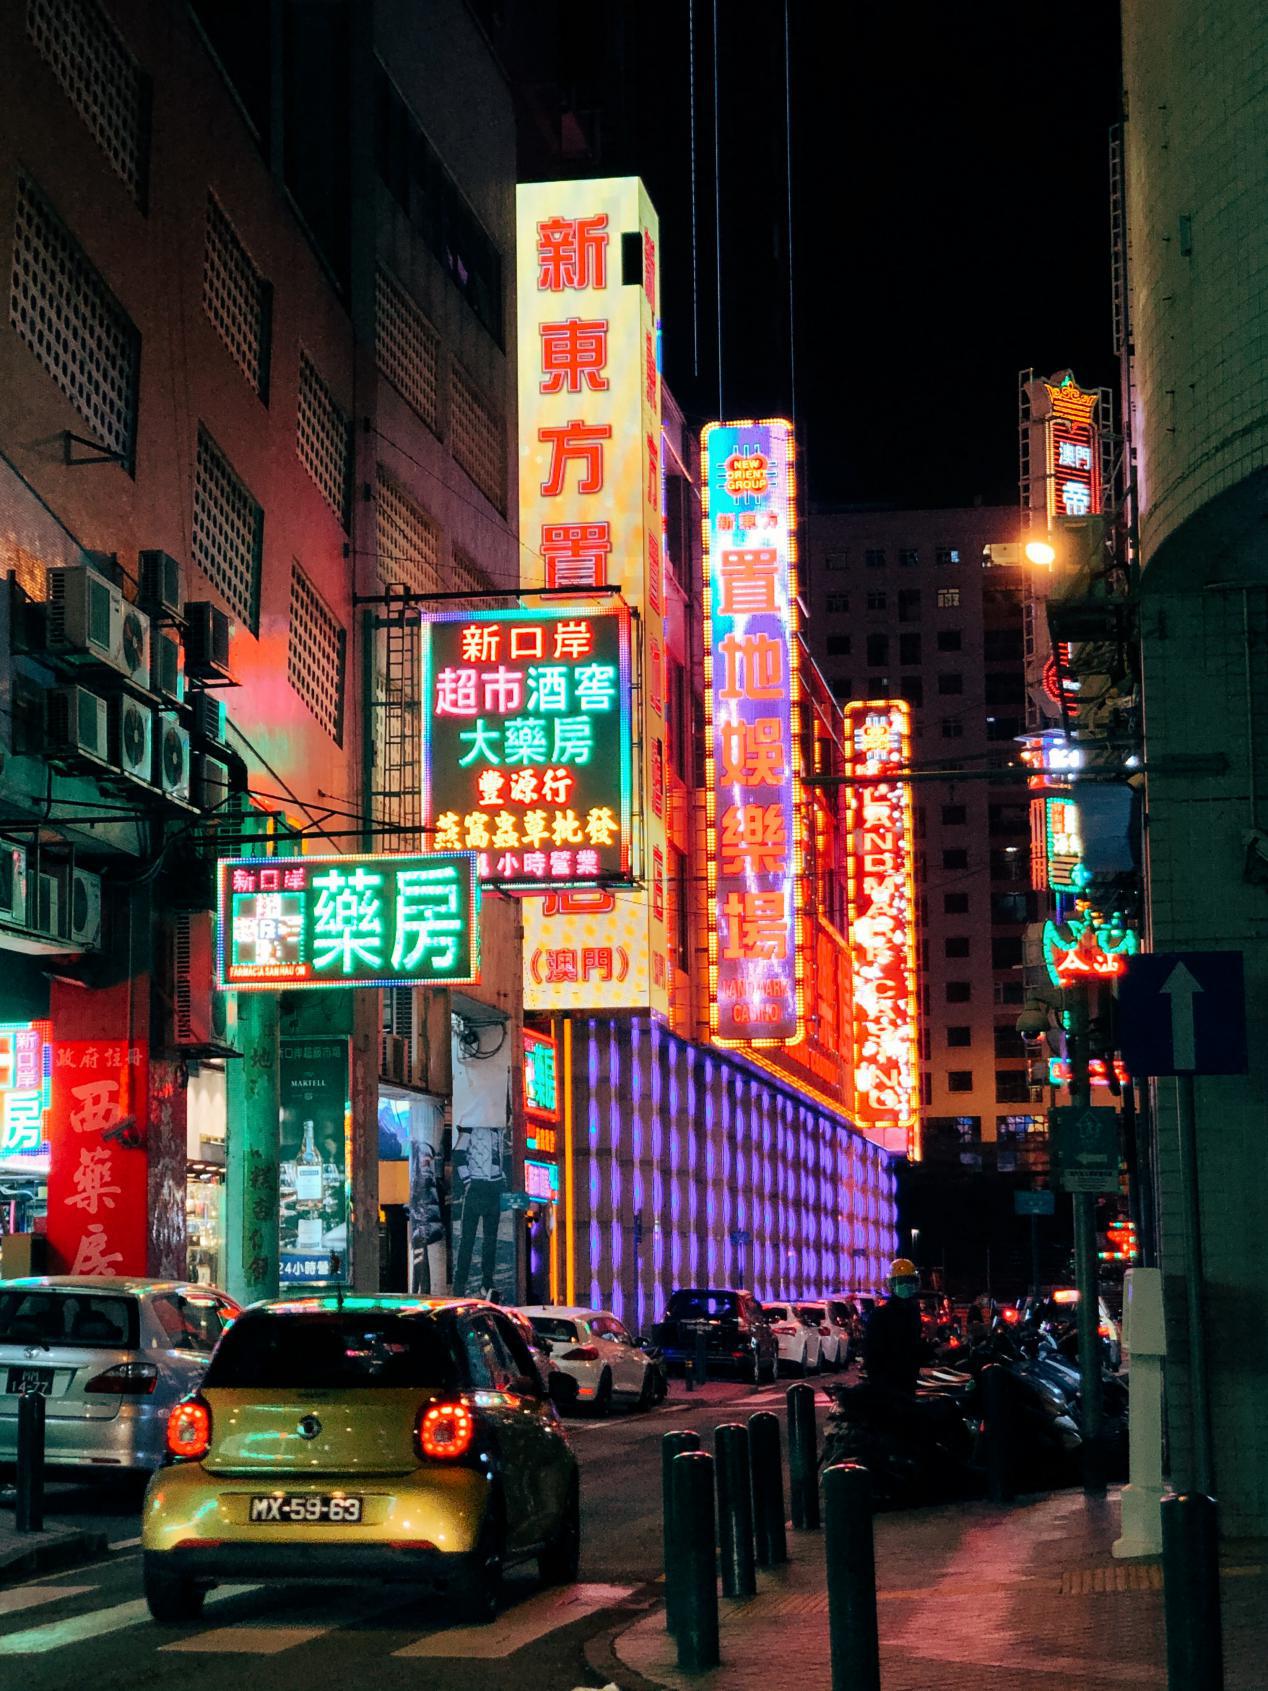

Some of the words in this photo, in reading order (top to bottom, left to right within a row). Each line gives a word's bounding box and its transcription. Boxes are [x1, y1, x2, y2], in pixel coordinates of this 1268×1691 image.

[728, 469, 767, 479] ORIENT
[734, 460, 759, 469] NEW
[727, 480, 766, 490] GROUP
[462, 621, 591, 662] 新口岸
[459, 716, 592, 767] 大藥房
[233, 867, 305, 892] 新口岸
[312, 866, 461, 973] 藥房
[733, 1003, 780, 1023] CASINO
[252, 1498, 360, 1520] MX-59-63
